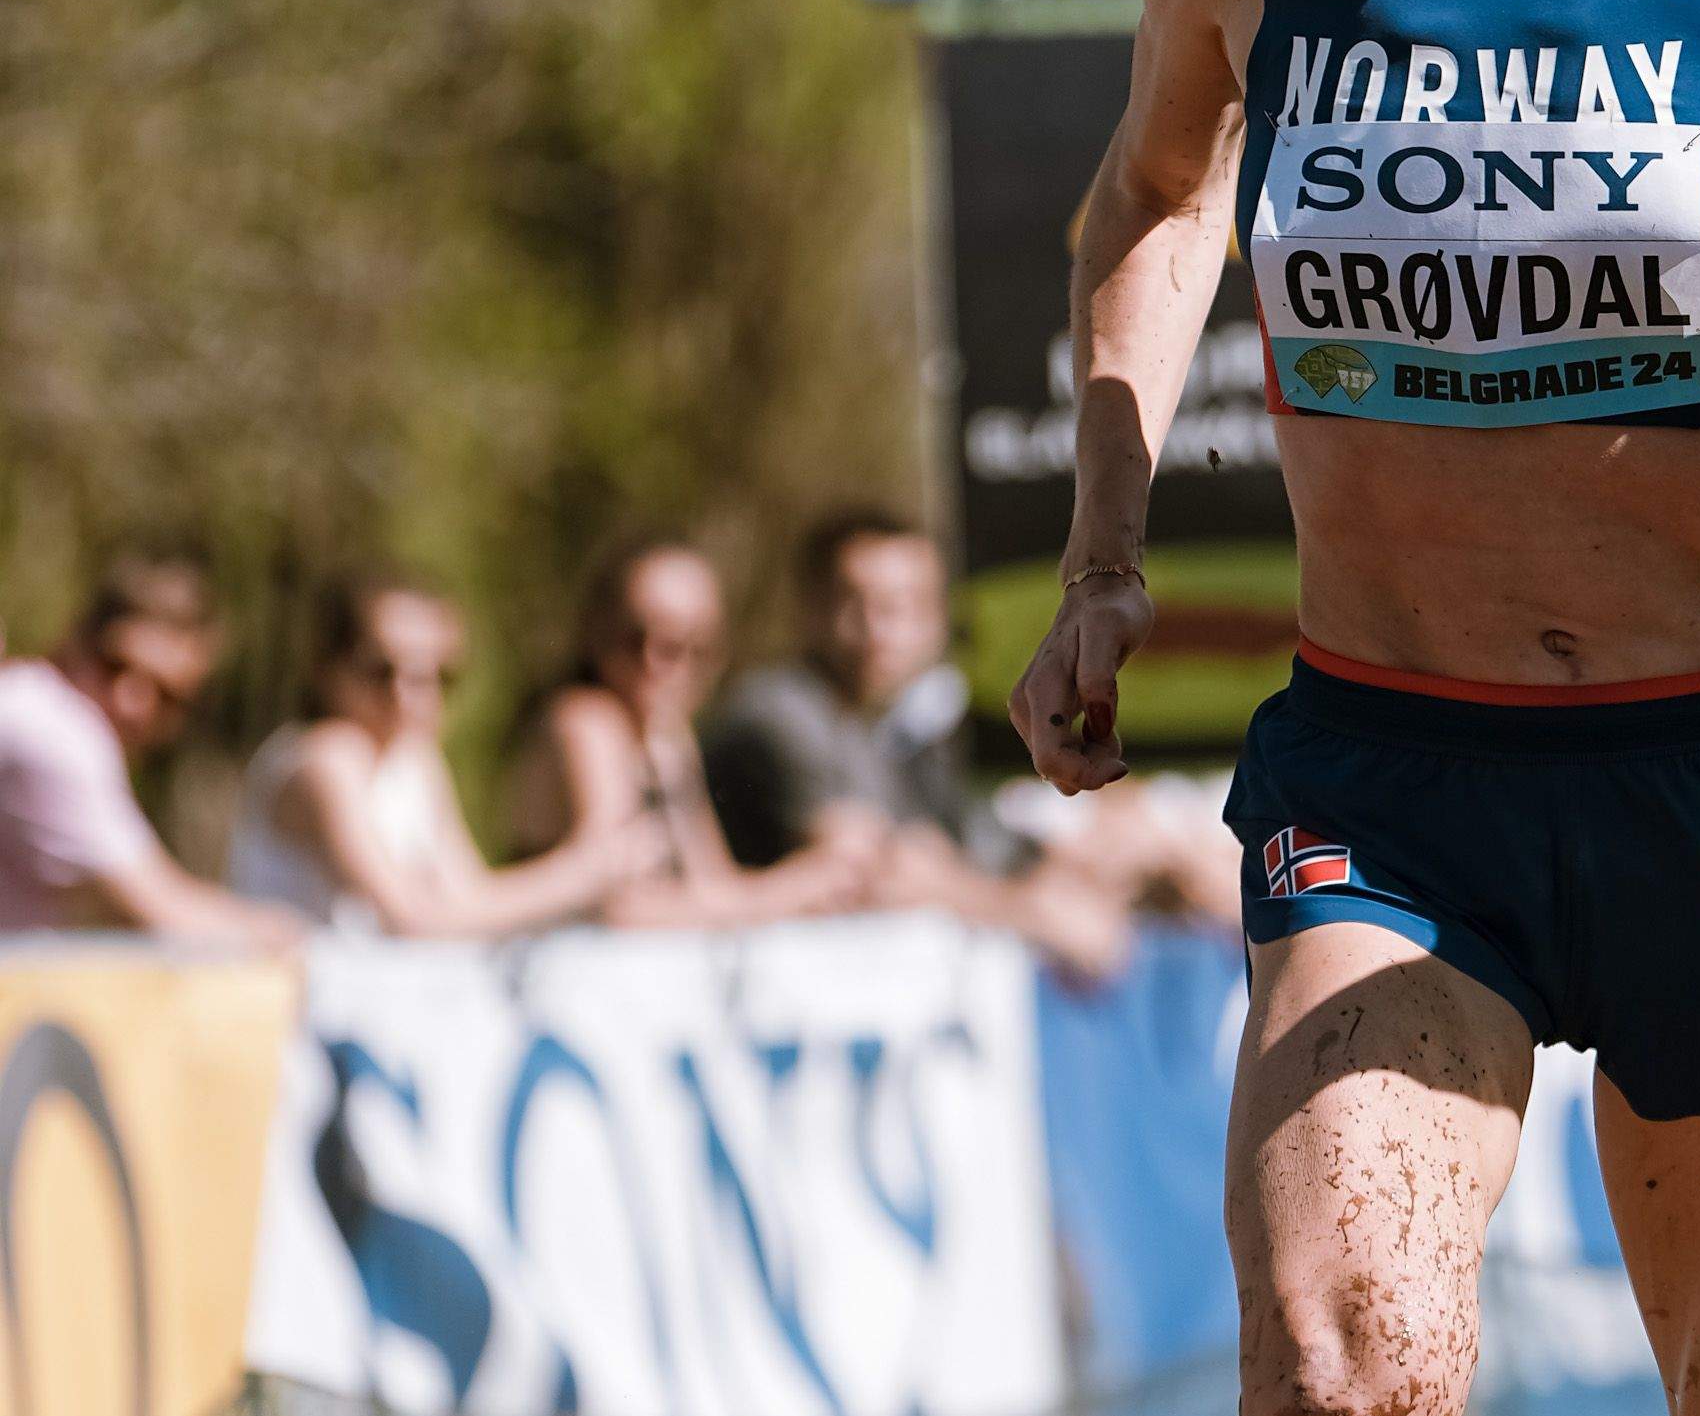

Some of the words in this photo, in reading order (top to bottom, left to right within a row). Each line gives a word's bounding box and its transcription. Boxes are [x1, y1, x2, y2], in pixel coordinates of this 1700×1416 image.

[1277, 36, 1683, 128] NORWAY
[1296, 145, 1664, 214] SONY
[1284, 248, 1691, 342] GRØVDAL
[1394, 356, 1625, 405] BELGRADE
[1630, 351, 1697, 387] 24
